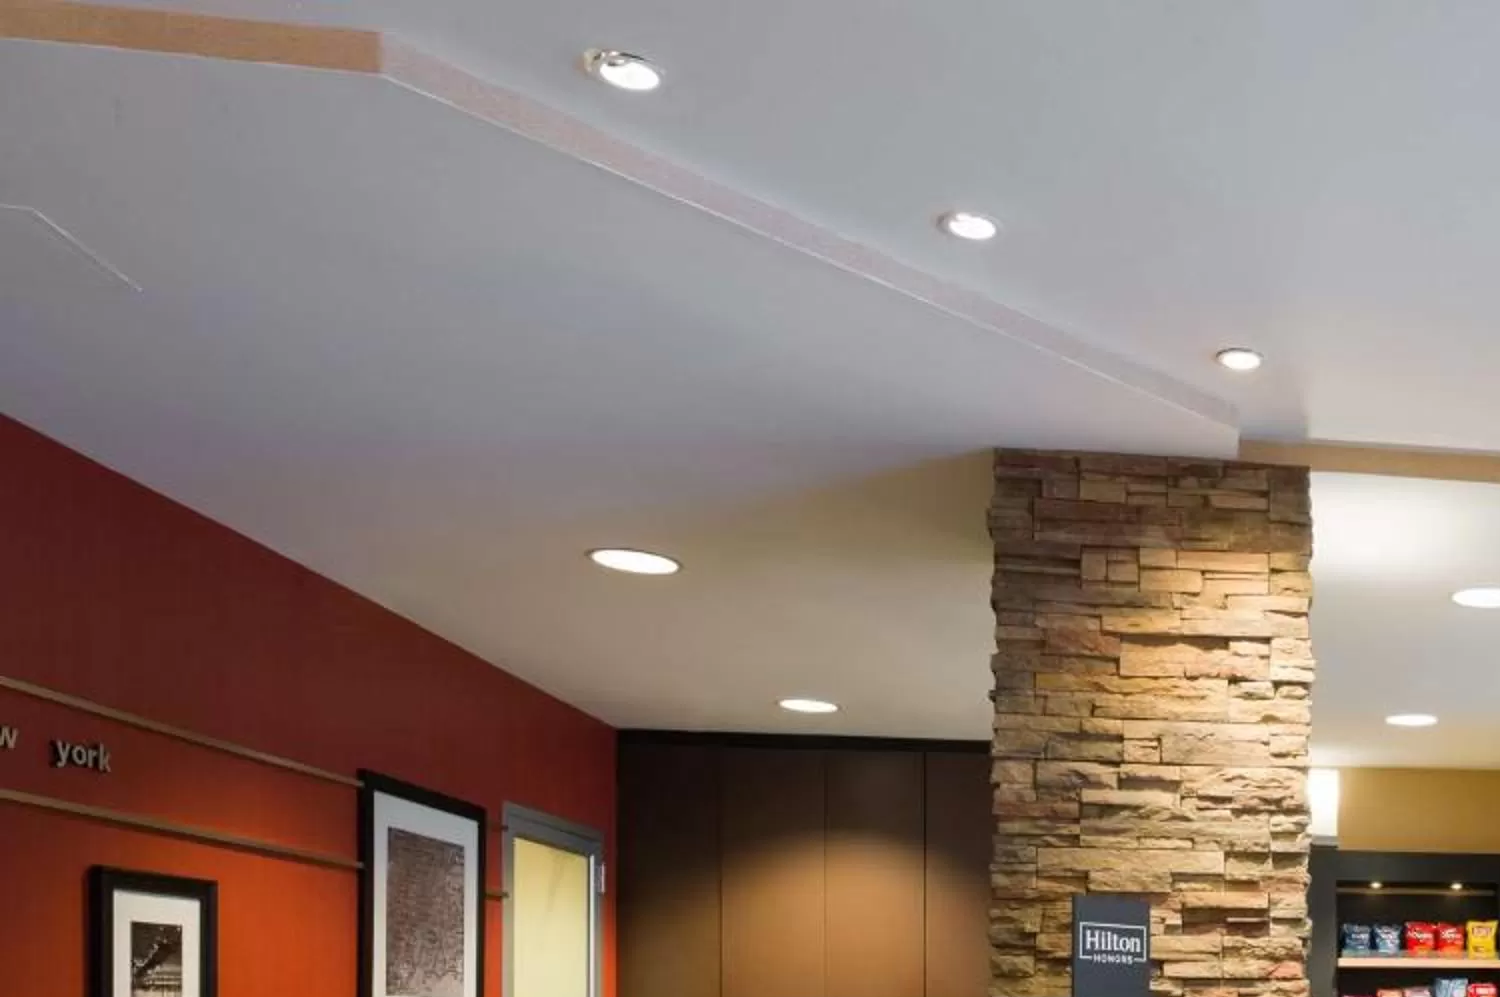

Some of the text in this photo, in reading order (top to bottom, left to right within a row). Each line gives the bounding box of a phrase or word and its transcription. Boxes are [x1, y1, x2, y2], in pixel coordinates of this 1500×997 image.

[56, 739, 112, 773] york
[1085, 929, 1141, 953] Hilton
[1093, 953, 1133, 965] HONORS
